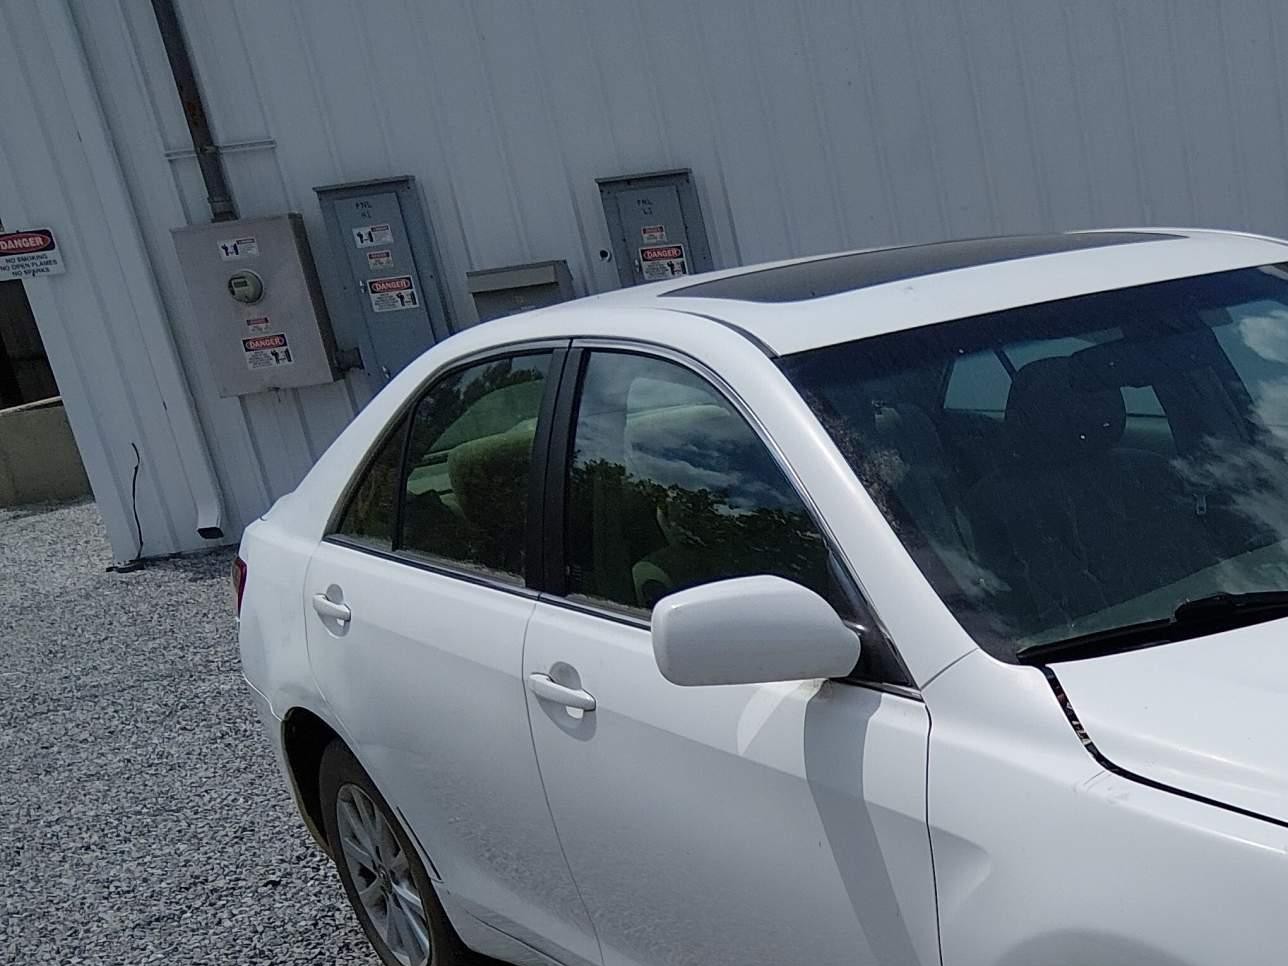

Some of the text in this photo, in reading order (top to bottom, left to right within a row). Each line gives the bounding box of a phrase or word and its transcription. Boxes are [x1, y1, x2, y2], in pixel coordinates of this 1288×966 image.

[0, 236, 44, 250] DANGER
[647, 248, 678, 259] DANGER
[375, 280, 407, 291] DANGER
[249, 337, 281, 349] DANGER
